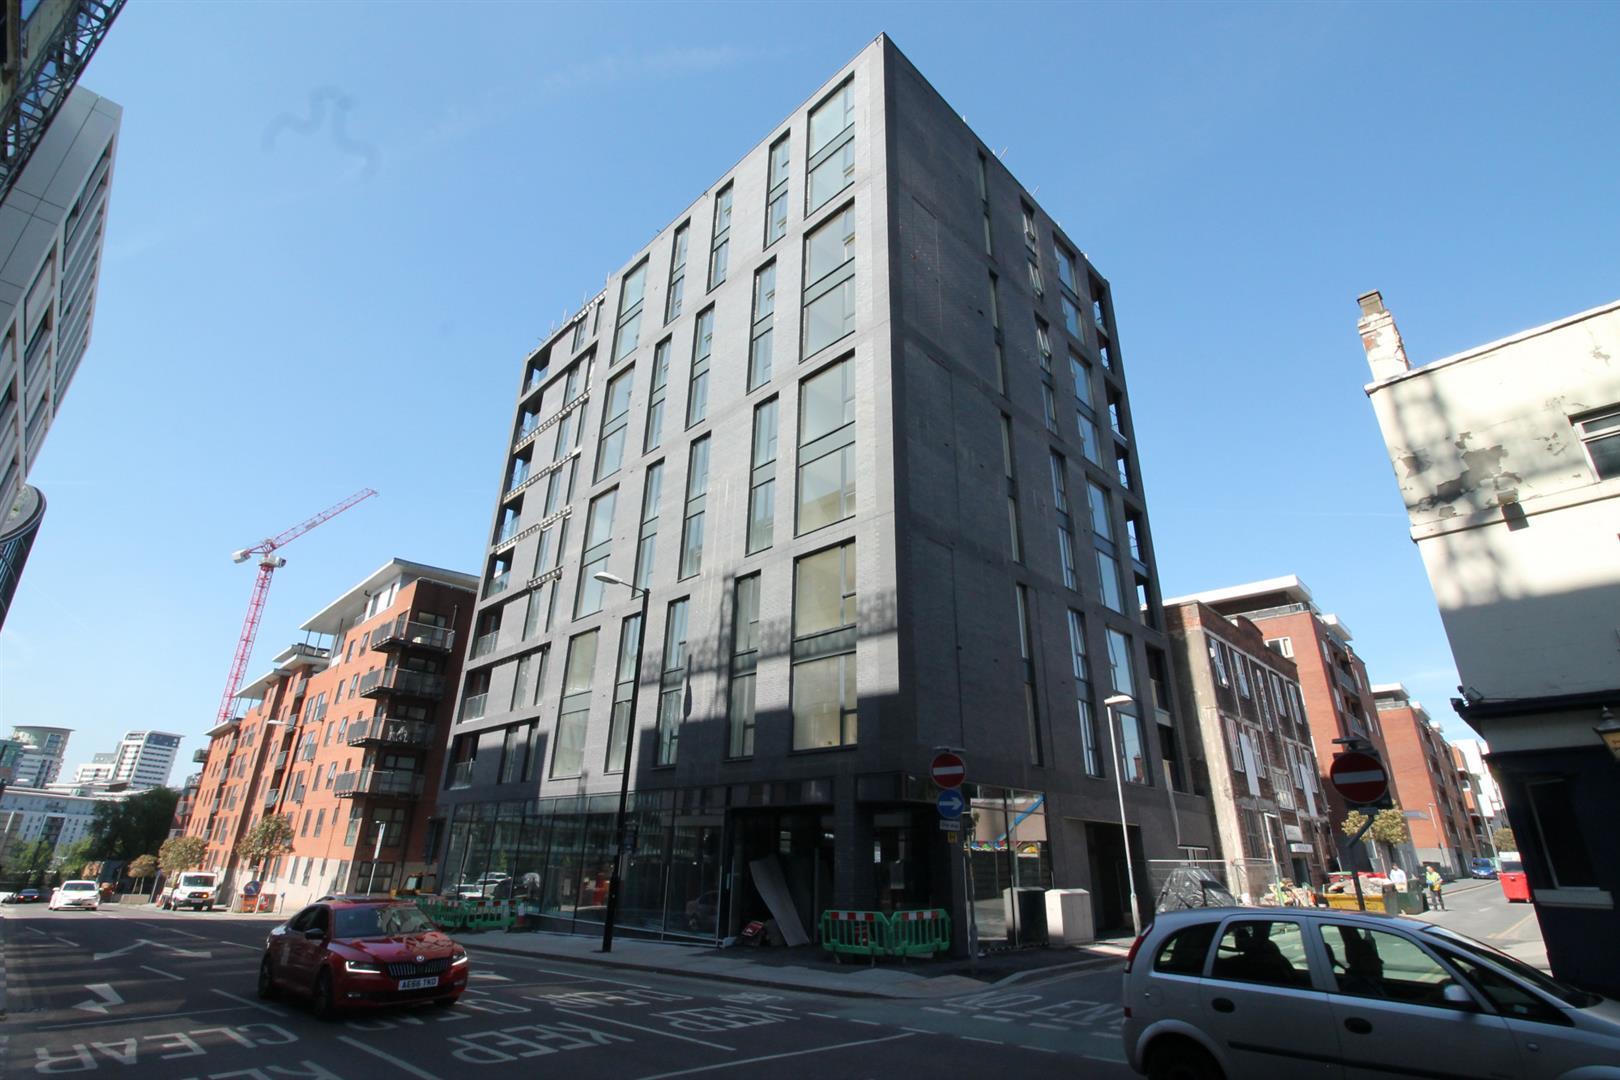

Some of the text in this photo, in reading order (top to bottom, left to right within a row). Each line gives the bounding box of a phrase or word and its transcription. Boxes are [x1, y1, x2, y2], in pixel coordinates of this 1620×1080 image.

[649, 1005, 800, 1032] KEEP
[34, 1023, 298, 1074] CLEAR
[446, 1021, 634, 1064] KEEP
